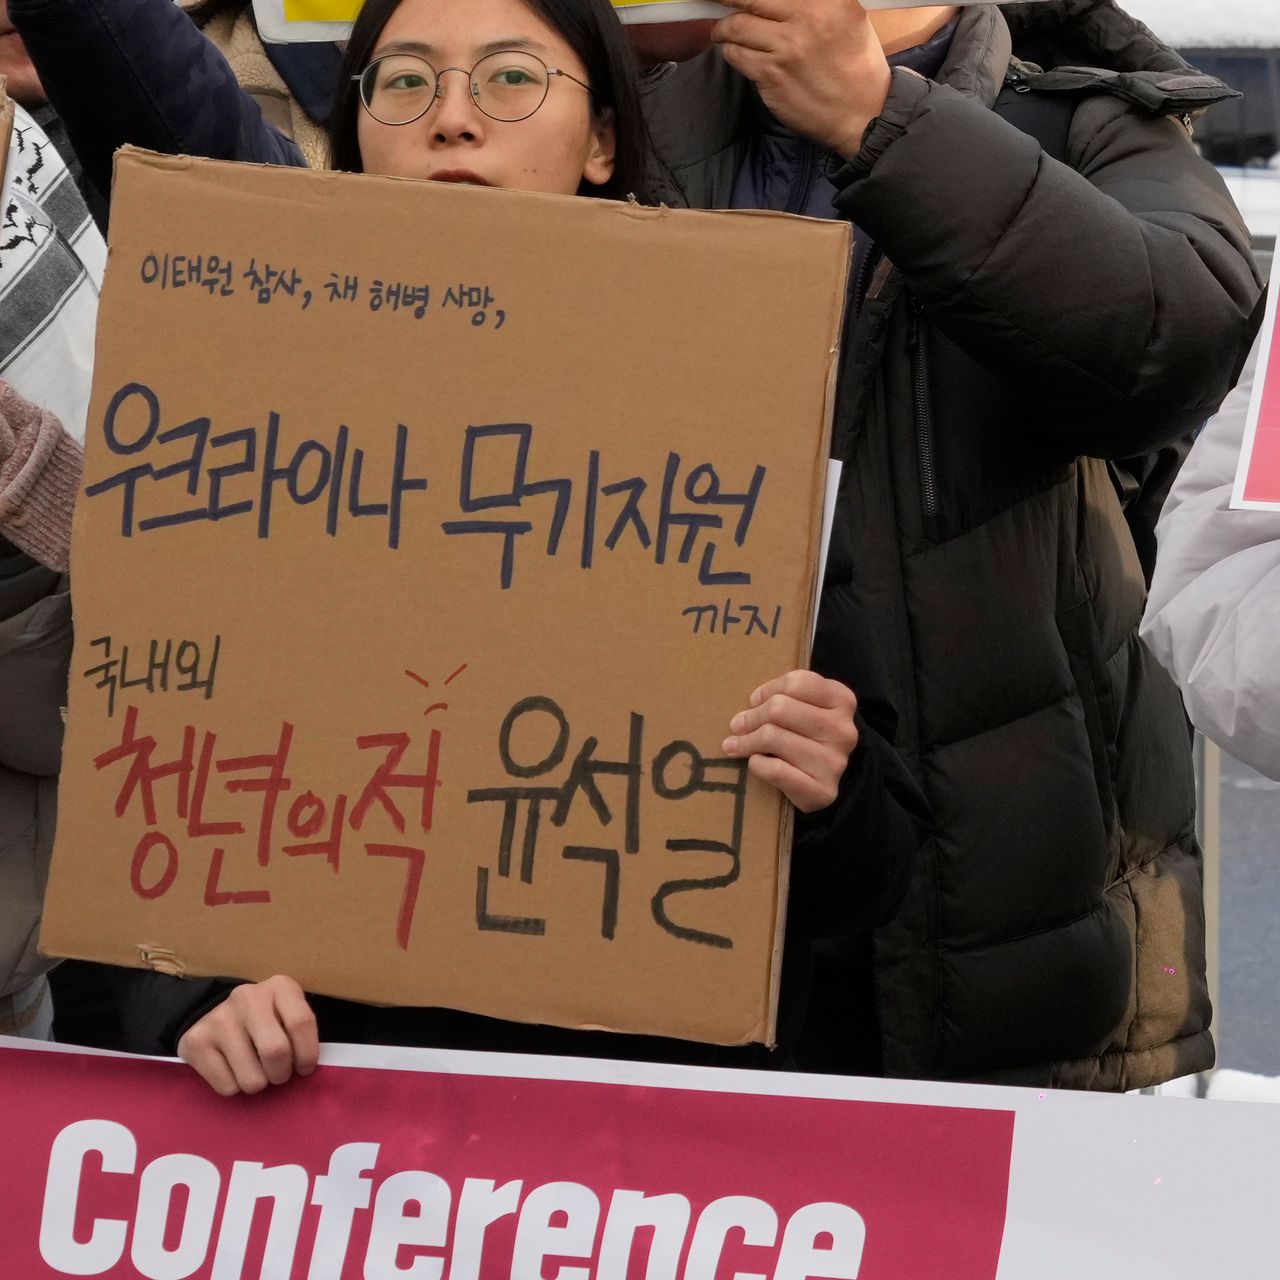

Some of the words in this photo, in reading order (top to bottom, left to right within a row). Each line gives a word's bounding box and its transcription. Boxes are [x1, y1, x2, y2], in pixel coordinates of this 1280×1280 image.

[142, 256, 233, 296] 이태원
[244, 260, 311, 309] 참사,
[325, 277, 357, 300] 채
[371, 281, 428, 319] 해병
[443, 285, 504, 328] 사망,
[85, 383, 427, 549] 우크라이나
[84, 635, 220, 717] 국내외
[683, 599, 780, 637] 까지
[468, 696, 750, 948] 윤석열
[40, 1120, 865, 1280] Conference
